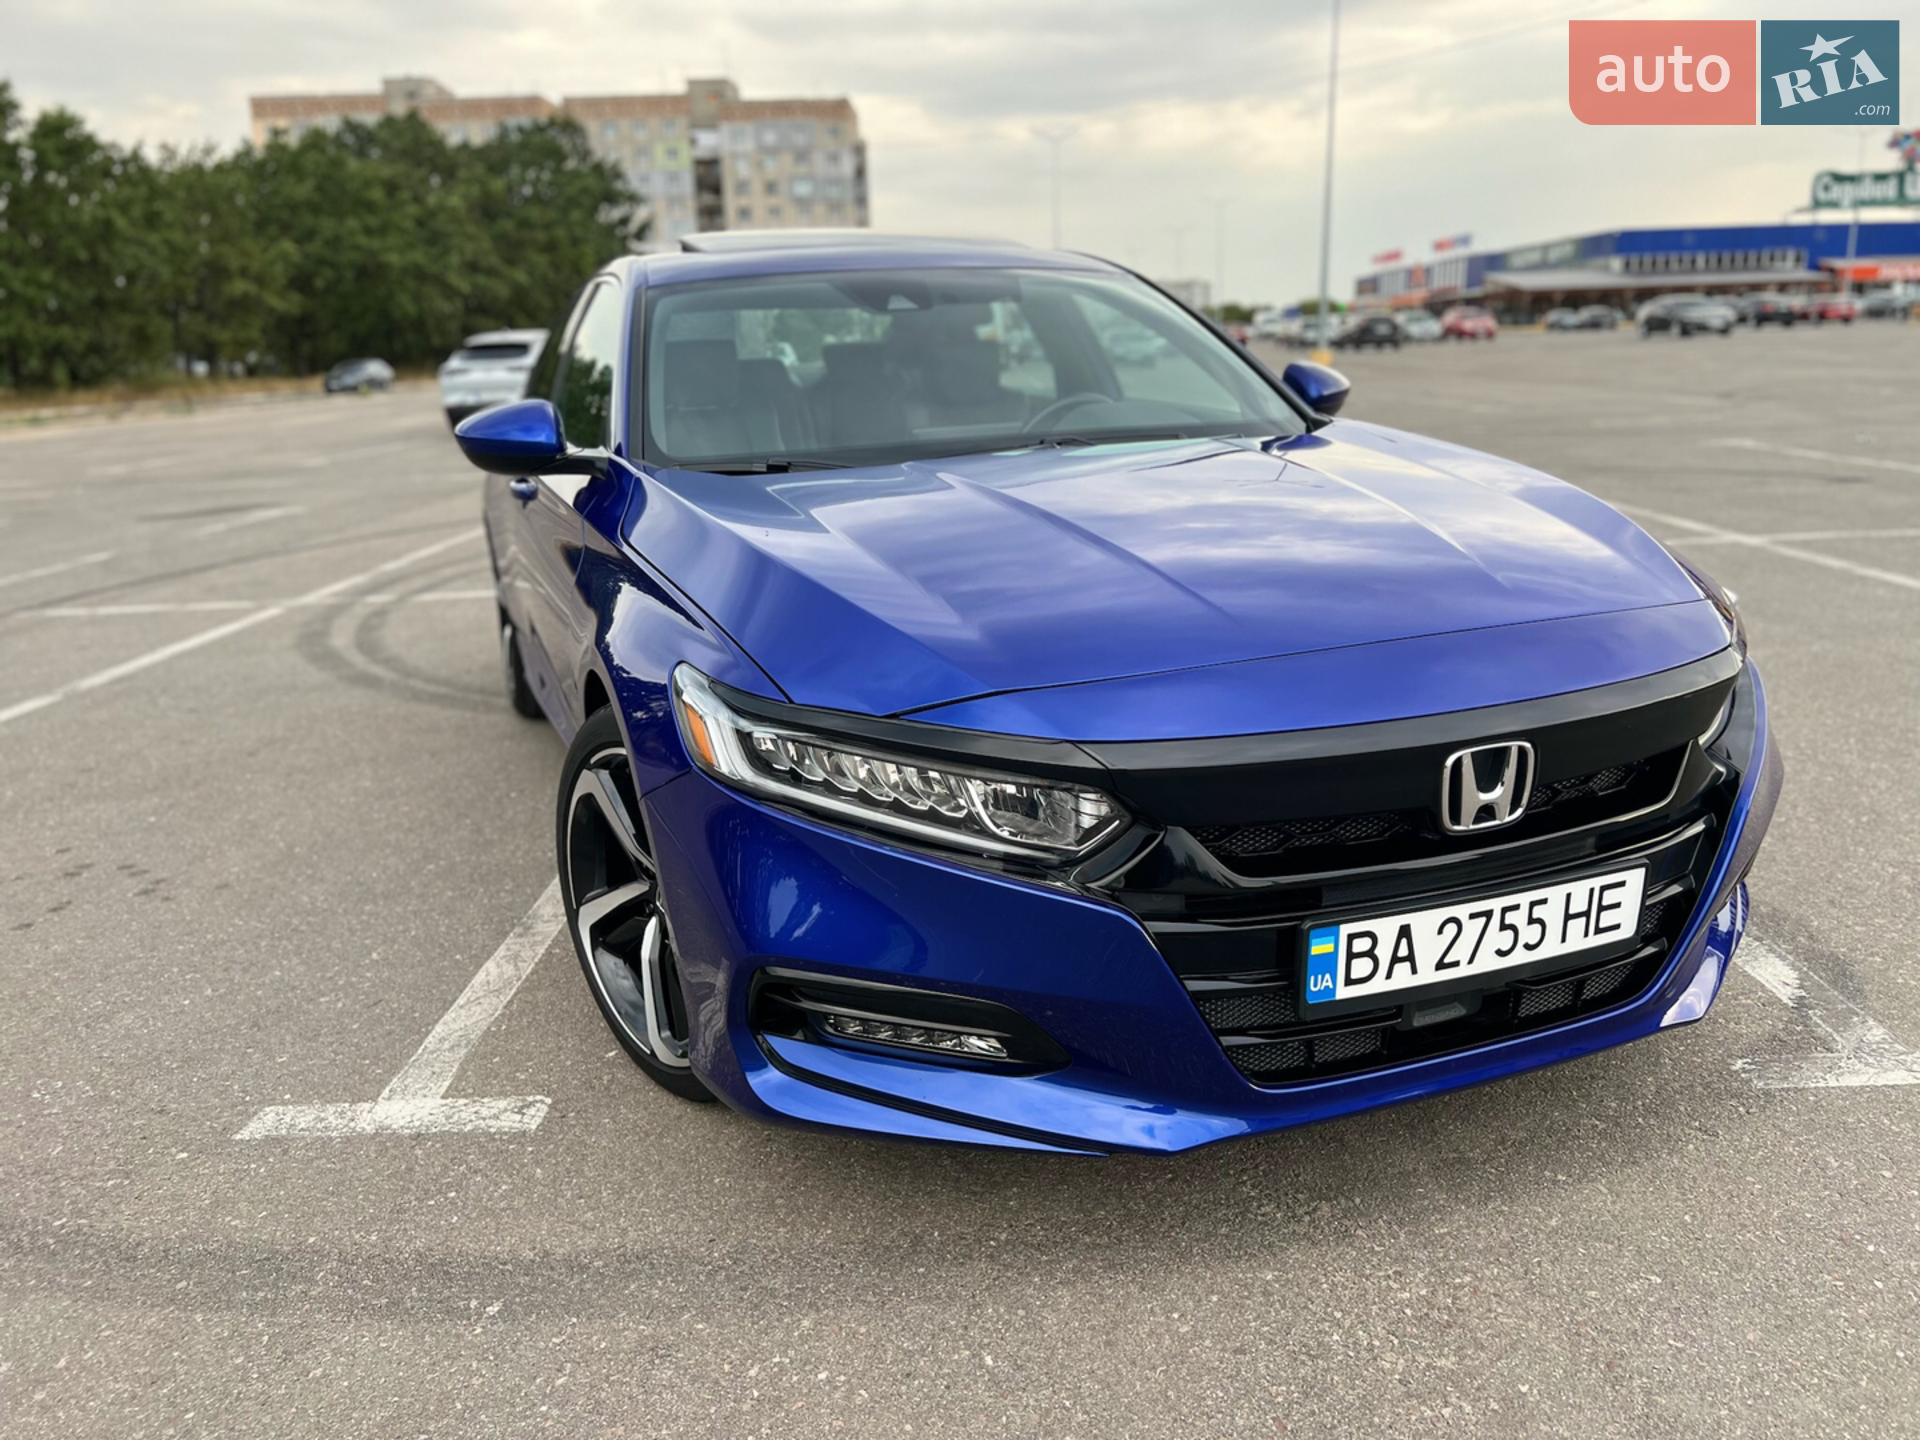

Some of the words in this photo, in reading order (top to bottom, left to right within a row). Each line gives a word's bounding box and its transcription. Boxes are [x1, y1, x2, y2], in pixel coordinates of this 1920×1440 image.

[1344, 923, 1418, 987] BA
[1434, 897, 1549, 971] 2755
[1560, 879, 1627, 944] HE
[1309, 972, 1334, 992] UA
